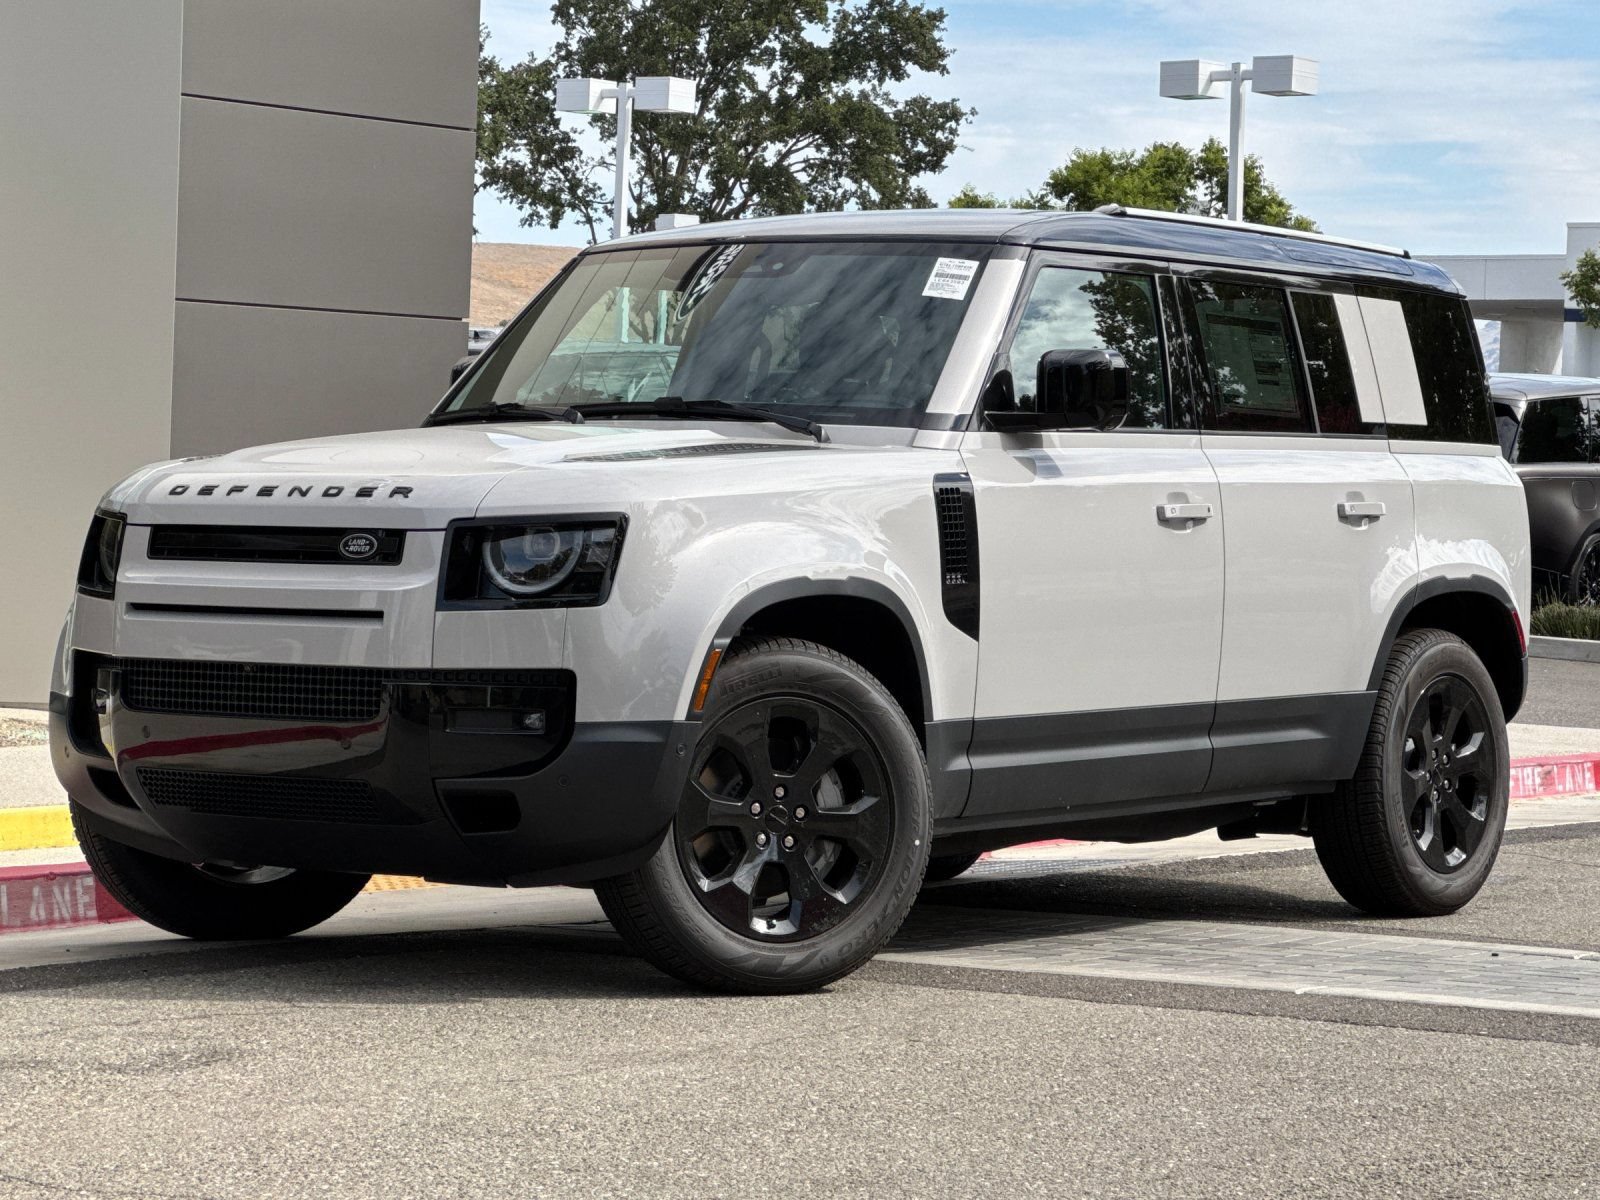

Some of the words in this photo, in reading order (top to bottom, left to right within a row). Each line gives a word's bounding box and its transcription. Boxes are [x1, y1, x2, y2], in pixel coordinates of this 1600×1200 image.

[168, 484, 414, 499] DEFENDER
[1553, 761, 1596, 792] LANE
[0, 877, 98, 926] LANE
